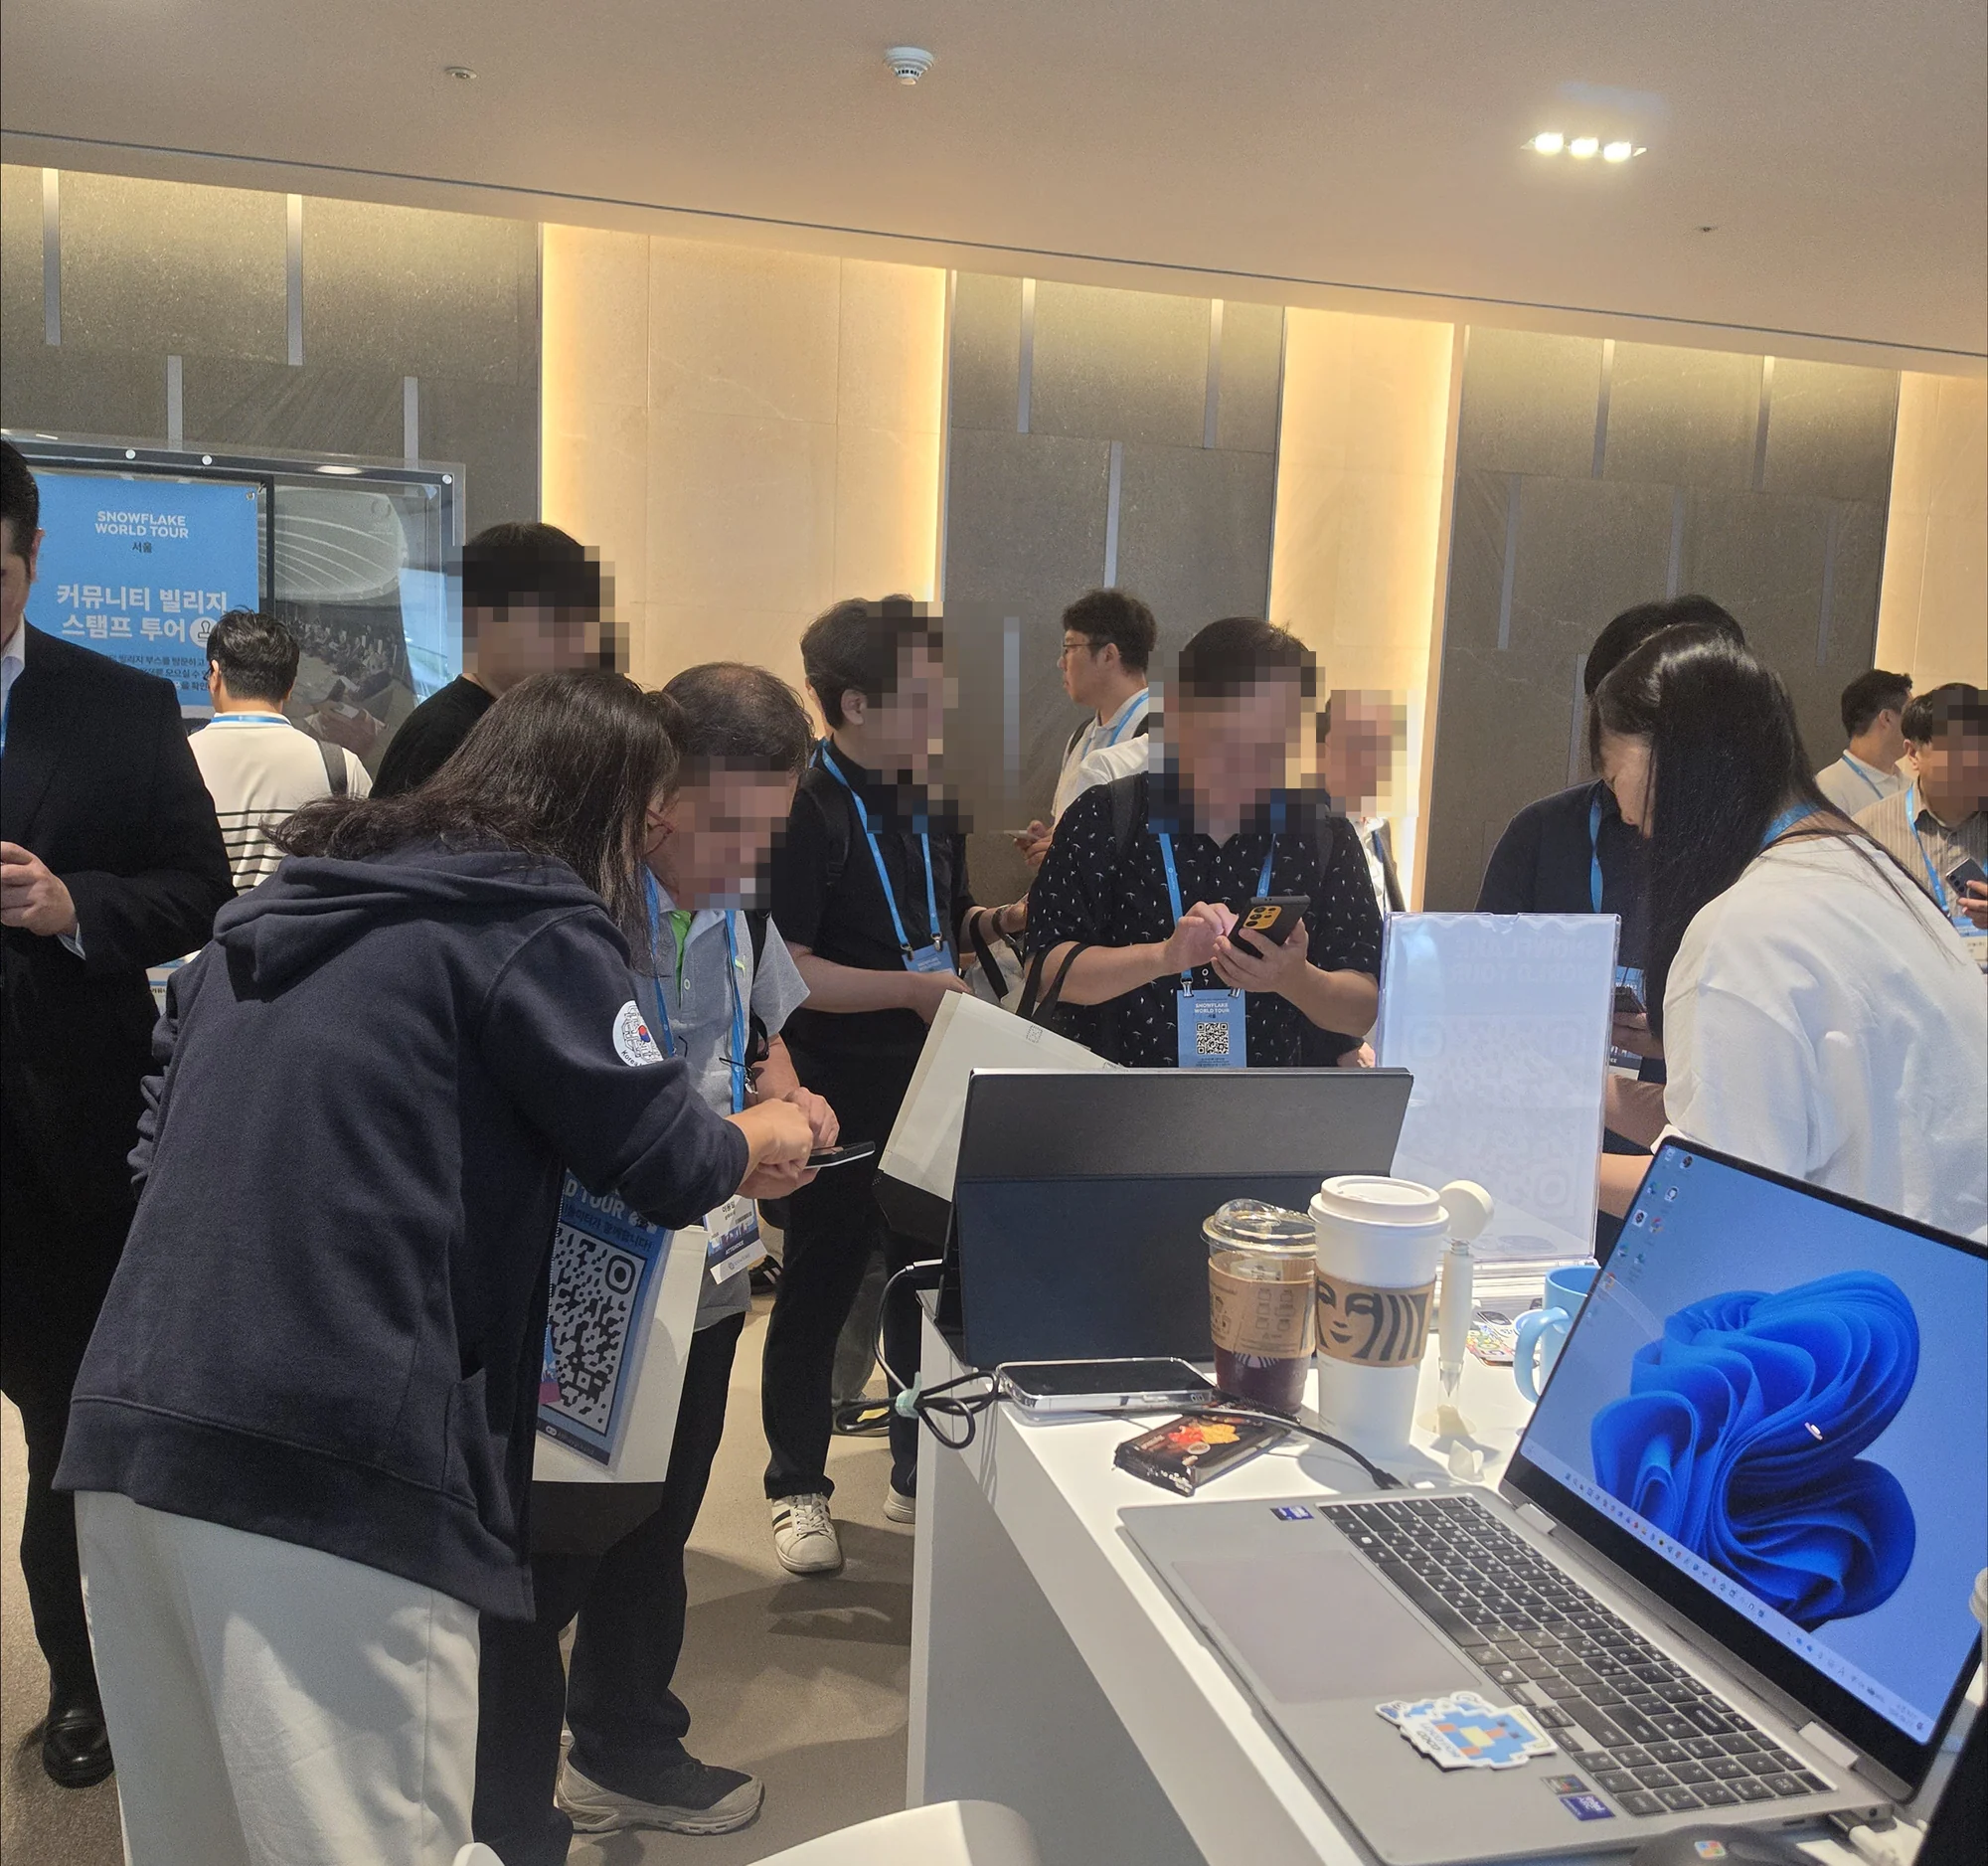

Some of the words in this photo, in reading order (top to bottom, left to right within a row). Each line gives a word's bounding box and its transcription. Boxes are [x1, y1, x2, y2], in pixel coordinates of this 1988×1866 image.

[97, 511, 186, 526] SNOWFLAKE
[94, 523, 147, 537] WORLD
[150, 526, 189, 538] TOUR
[132, 542, 152, 553] 서울
[57, 584, 150, 611] 커뮤니티
[159, 588, 227, 614] 빌리지
[62, 614, 132, 639] 스탬프
[140, 617, 185, 643] 투어
